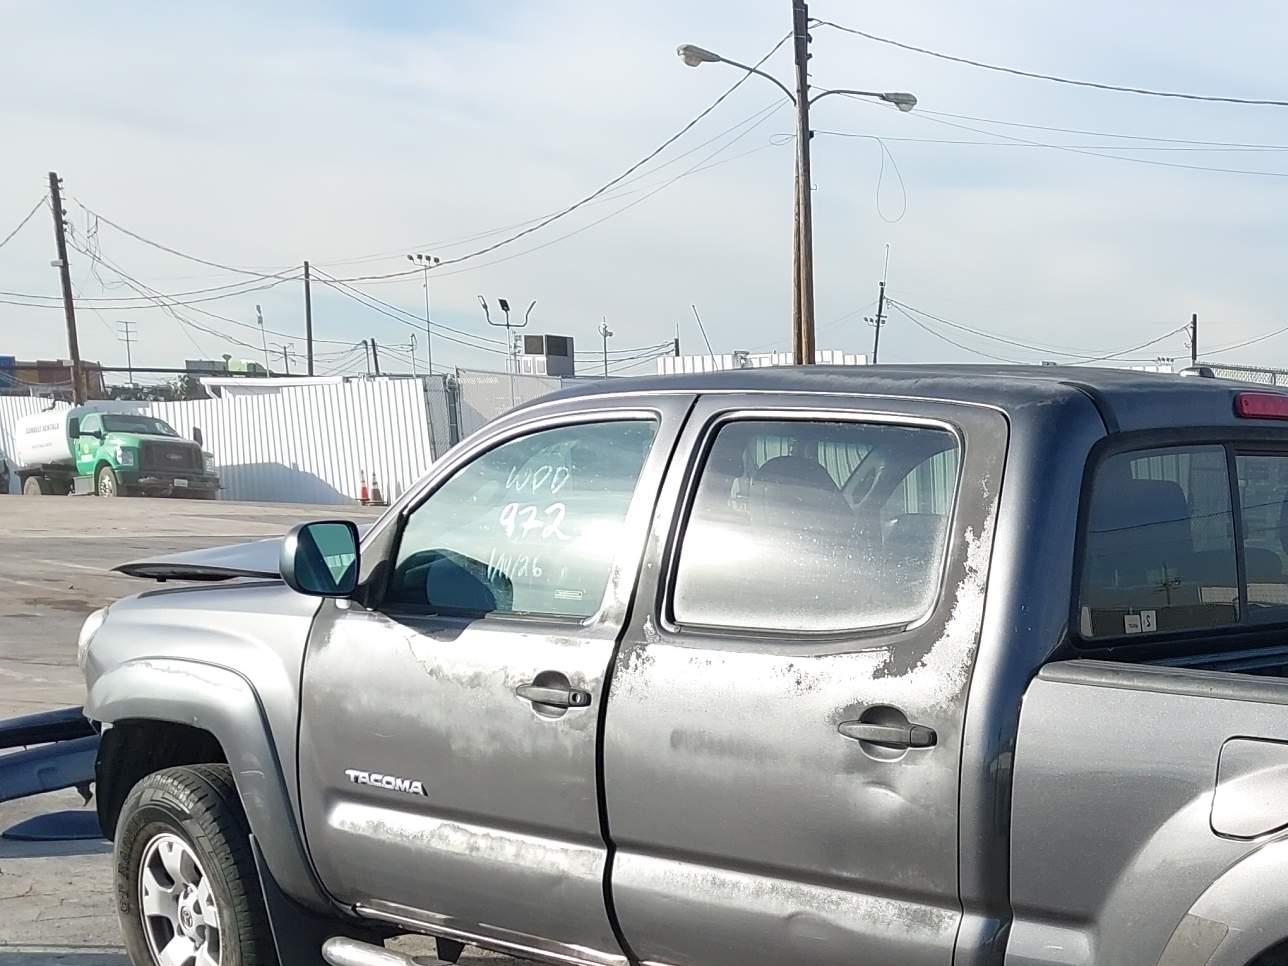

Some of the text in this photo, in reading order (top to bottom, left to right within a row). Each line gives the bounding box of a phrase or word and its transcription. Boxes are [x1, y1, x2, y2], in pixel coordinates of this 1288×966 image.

[505, 466, 569, 495] WPD
[500, 502, 571, 540] 972
[345, 769, 427, 796] TACOMA
